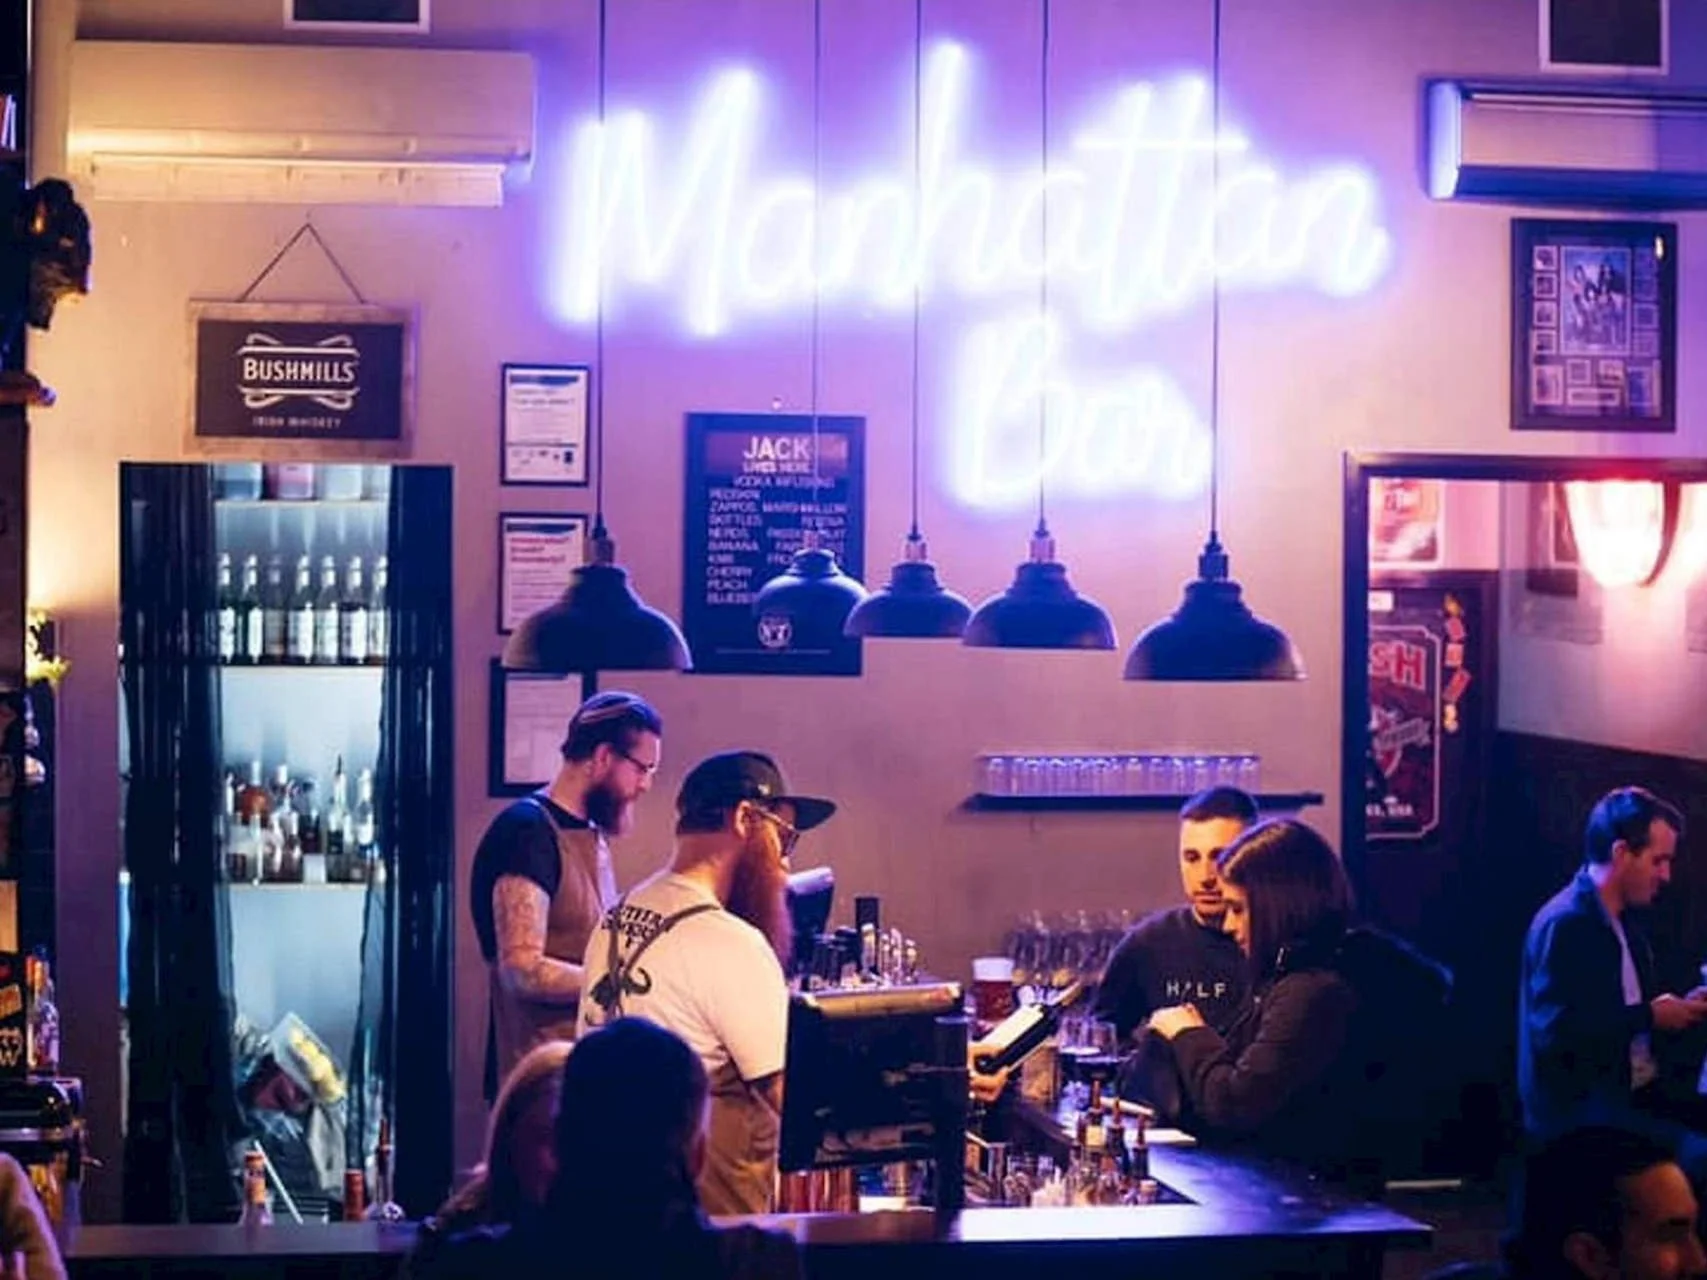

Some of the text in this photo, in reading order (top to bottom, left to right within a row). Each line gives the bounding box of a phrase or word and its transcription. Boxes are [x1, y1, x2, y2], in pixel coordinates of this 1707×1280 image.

[556, 41, 1388, 336] Manhattan
[243, 358, 355, 383] BUSHMILLS
[950, 312, 1215, 508] Bar
[743, 436, 811, 459] JACK
